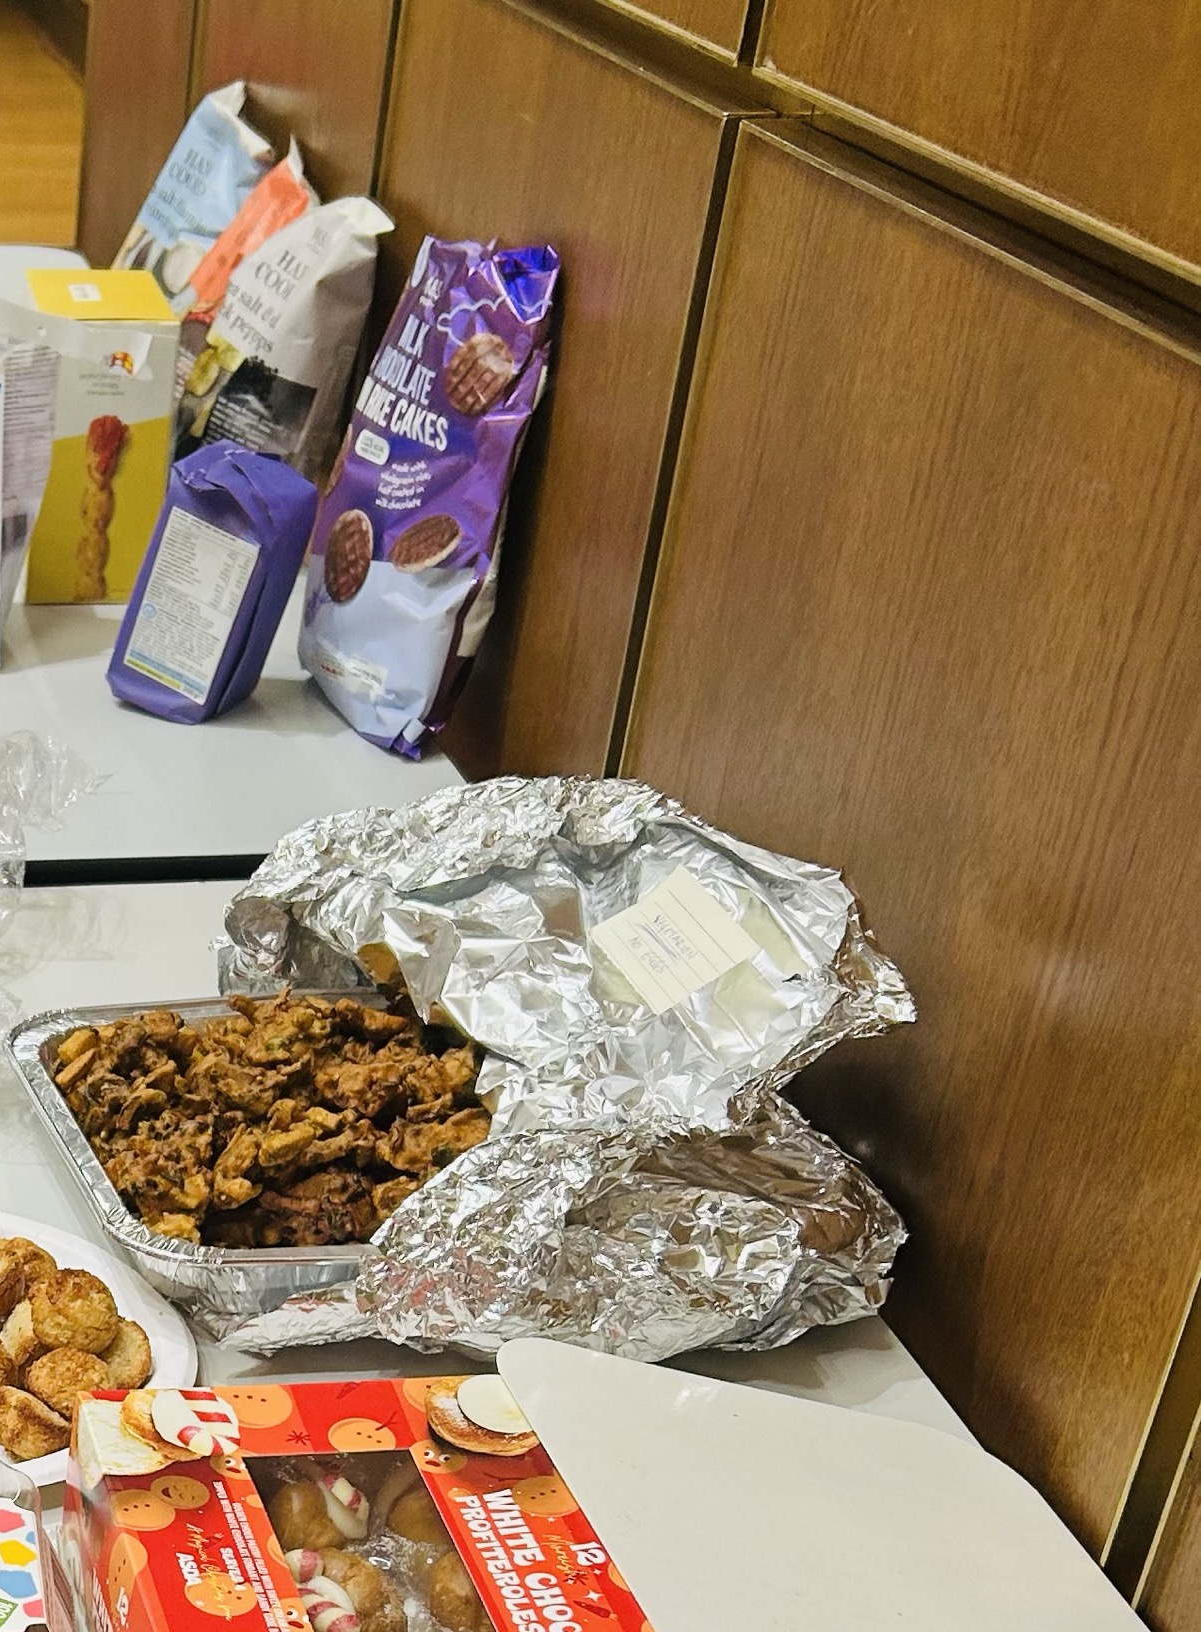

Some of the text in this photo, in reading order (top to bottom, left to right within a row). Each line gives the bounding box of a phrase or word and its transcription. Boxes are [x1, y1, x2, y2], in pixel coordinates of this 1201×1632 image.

[390, 398, 449, 452] CAKES
[483, 1488, 547, 1566] WHITE
[176, 1553, 203, 1587] ASDA
[570, 1542, 607, 1566] 12
